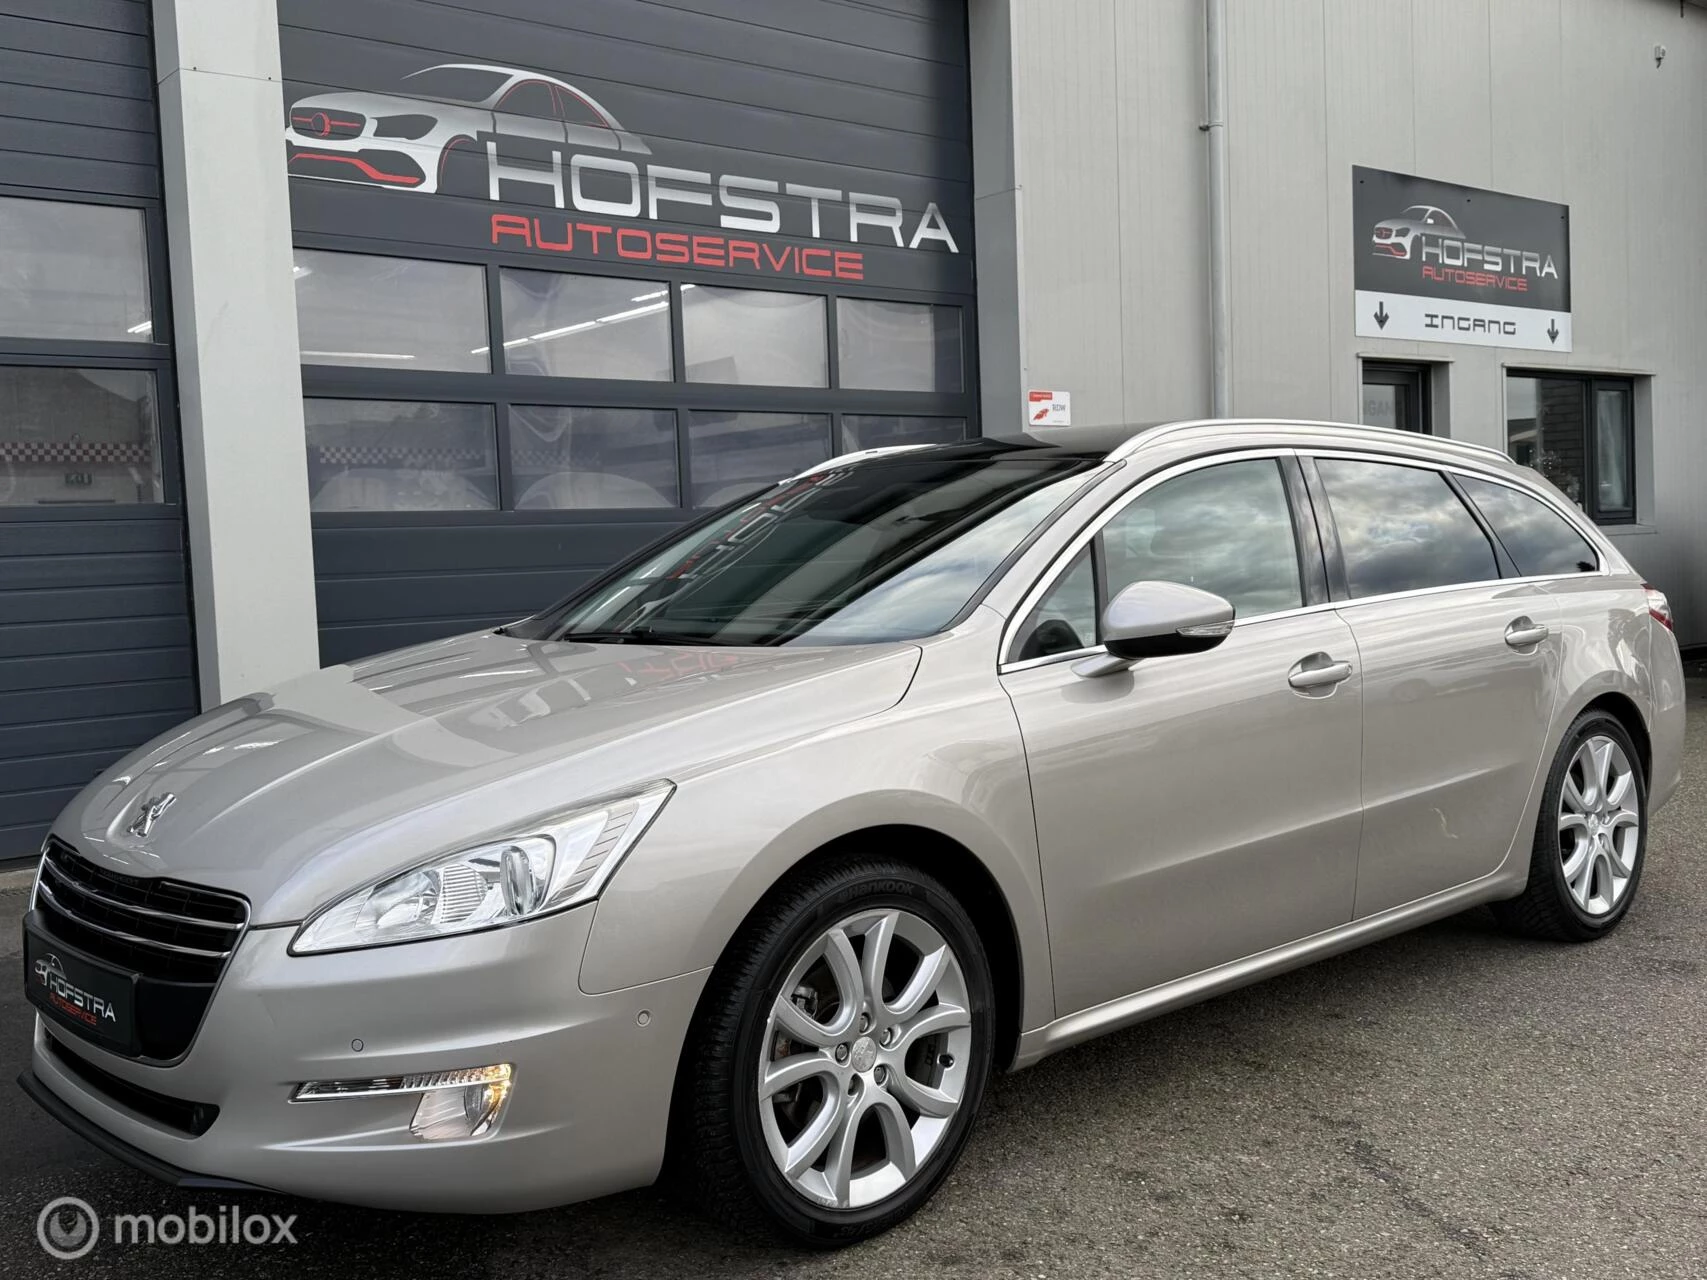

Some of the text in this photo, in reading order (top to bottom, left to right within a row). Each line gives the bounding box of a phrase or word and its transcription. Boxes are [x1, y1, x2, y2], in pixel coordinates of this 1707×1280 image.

[485, 141, 959, 254] HOFSTRA
[491, 214, 864, 281] AUTOSERVICE
[1421, 236, 1558, 279] HOFSTRA
[1422, 265, 1528, 291] AUTOSERVICE
[1424, 313, 1516, 335] INGANG
[49, 972, 116, 1022] HOFSTRA
